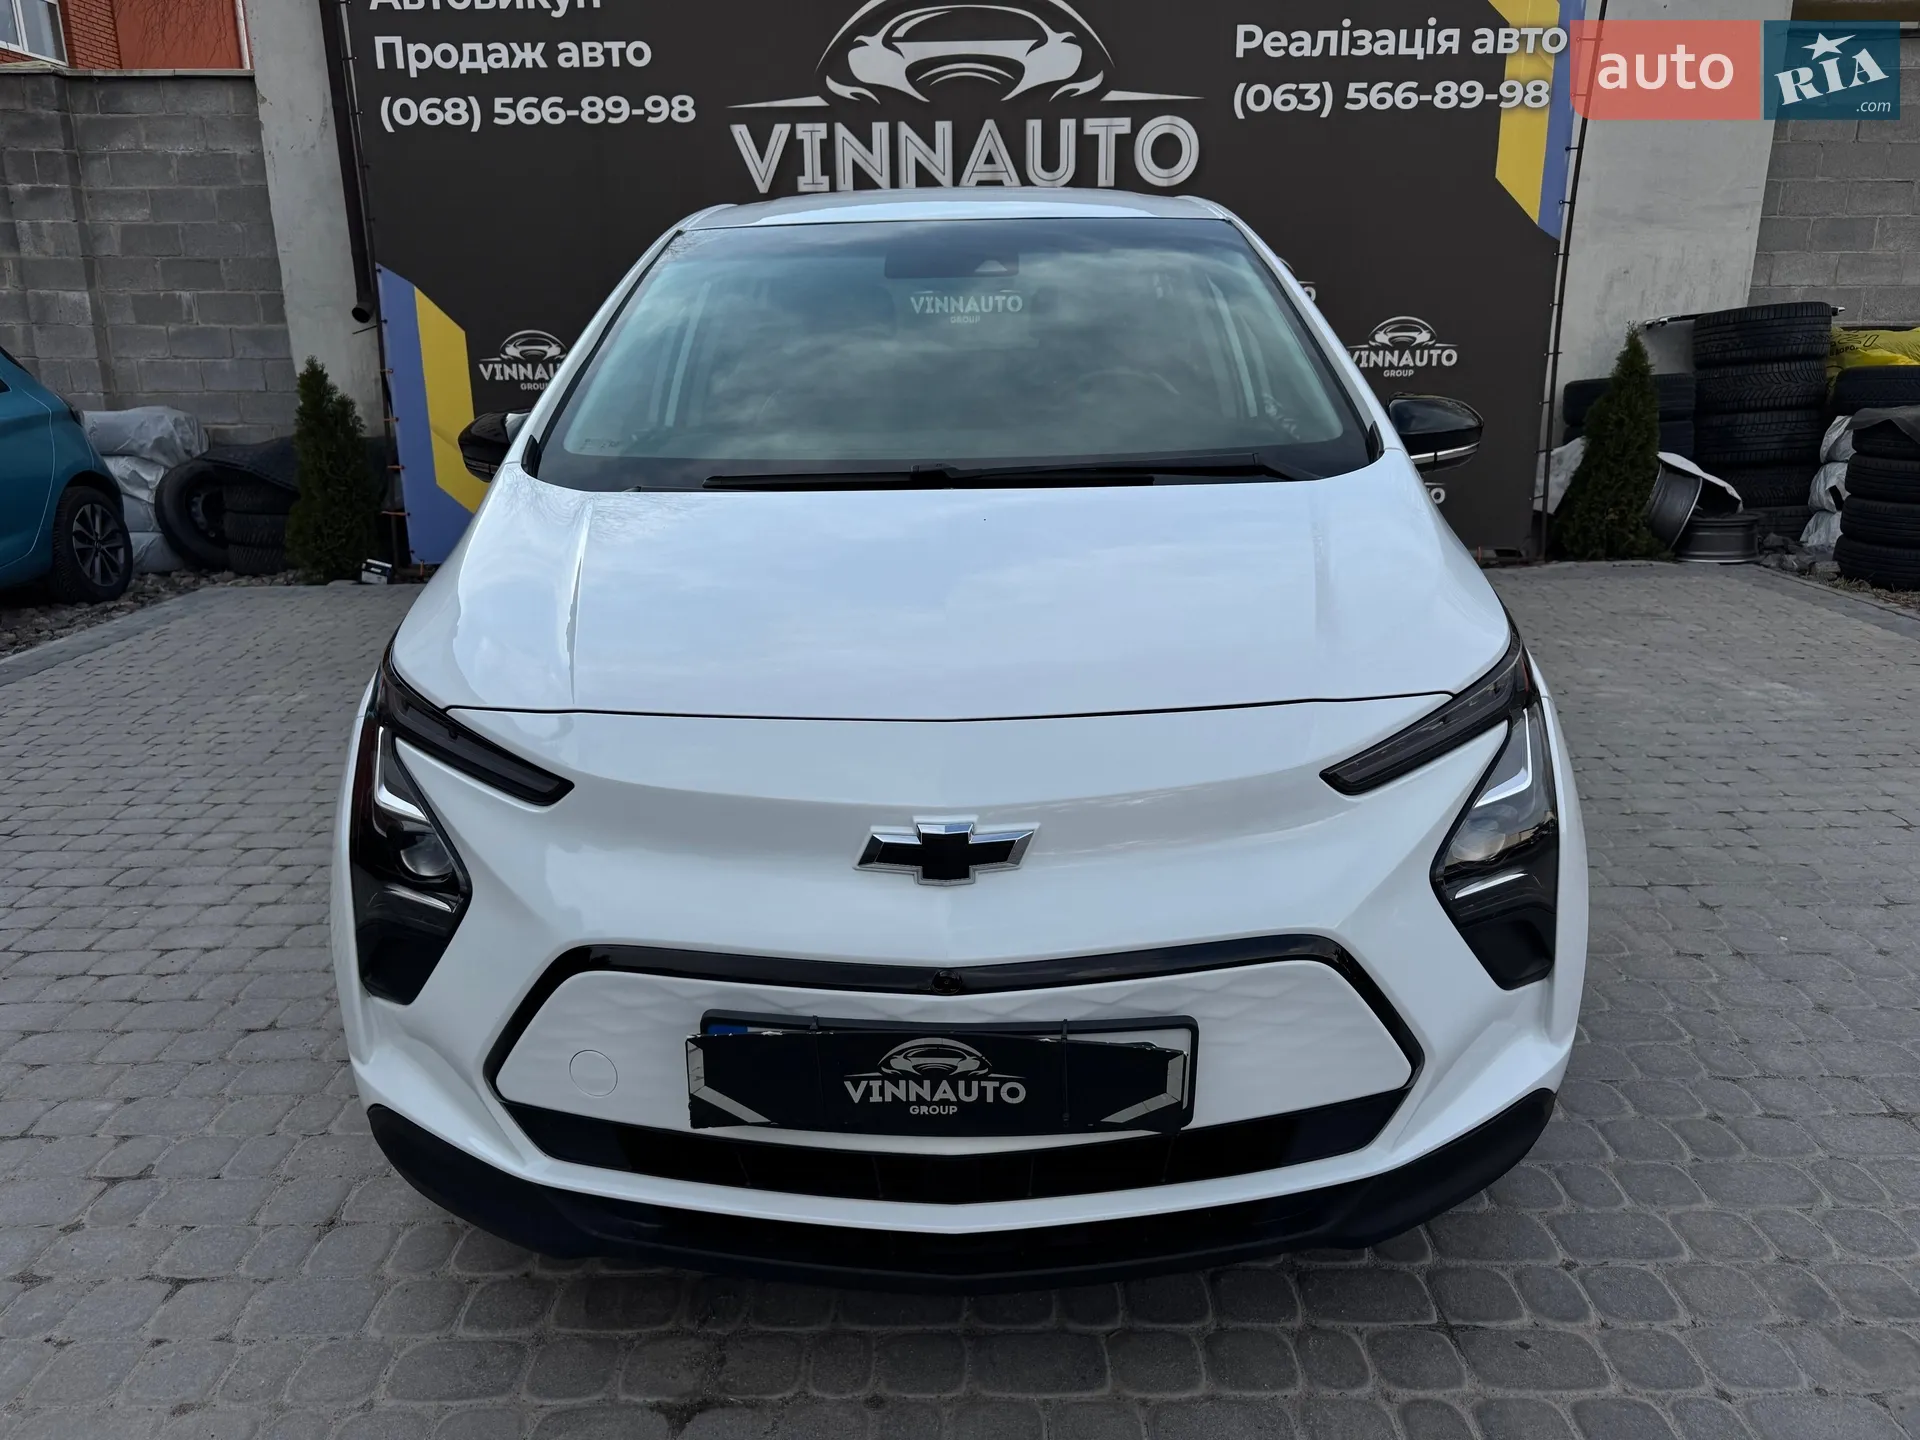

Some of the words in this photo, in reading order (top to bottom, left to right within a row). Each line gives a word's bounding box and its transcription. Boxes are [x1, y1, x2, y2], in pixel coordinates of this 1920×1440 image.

[1235, 17, 1460, 60] Реалізація
[1471, 27, 1567, 54] авто
[374, 36, 548, 78] Продаж
[557, 40, 652, 68] авто
[1234, 81, 1334, 119] (063)
[1345, 80, 1550, 111] 566-89-98
[380, 96, 481, 132] (068)
[493, 95, 696, 125] 566-89-98
[730, 115, 1200, 194] VINNAUTO
[910, 295, 1023, 314] VINNAUTO
[950, 315, 980, 324] GROUP
[1383, 369, 1414, 377] GROUP
[520, 382, 548, 391] GROU
[844, 1080, 1026, 1104] VINNAUTO
[909, 1105, 958, 1115] GROUP
